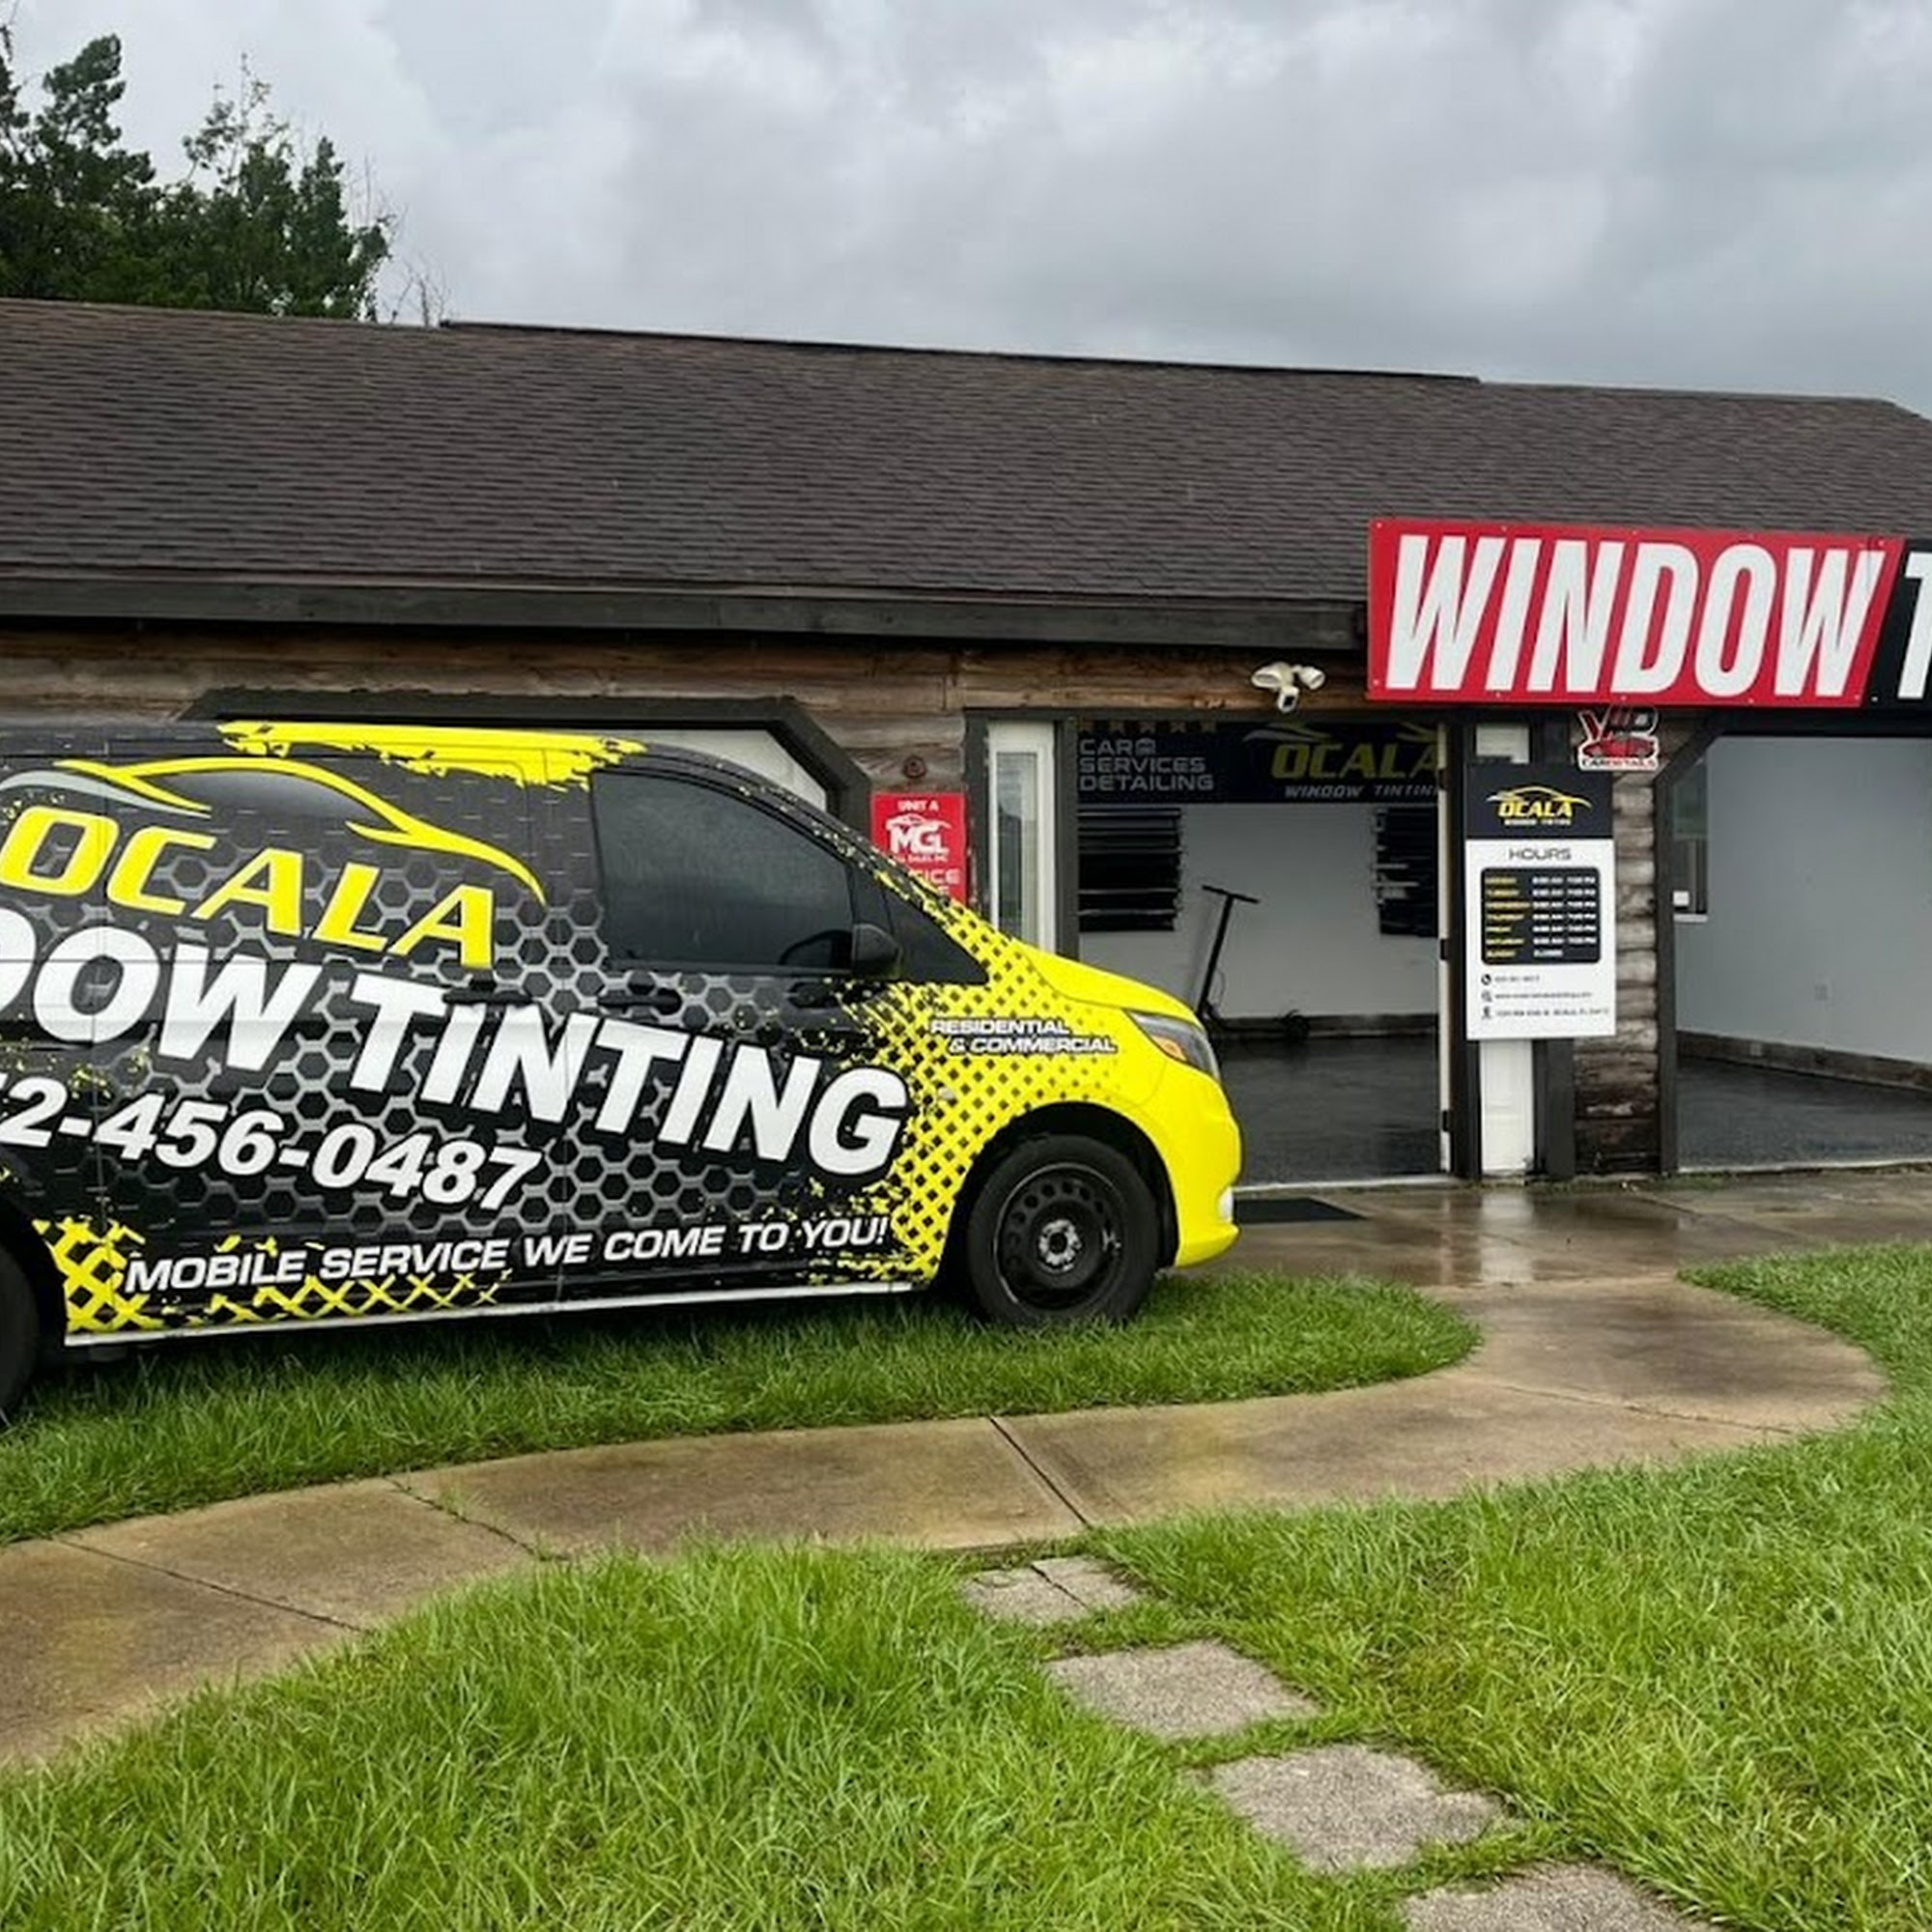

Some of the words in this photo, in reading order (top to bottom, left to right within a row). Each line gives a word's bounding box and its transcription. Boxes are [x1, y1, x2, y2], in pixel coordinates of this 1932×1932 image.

[1385, 534, 1887, 699] WINDOW
[1079, 738, 1134, 756] CAR
[1079, 756, 1207, 774] SERVICES
[1271, 743, 1438, 779] OCALA
[1079, 774, 1214, 791] DETAILING
[1285, 785, 1365, 798] WINDOW
[928, 800, 940, 811] A
[1497, 800, 1573, 818] OCALA
[1509, 848, 1573, 861] HOURS
[0, 806, 495, 969] OCALA
[930, 1018, 1071, 1036] RESIDENTIAL
[949, 1037, 966, 1053] &
[970, 1037, 1119, 1053] COMMERCIAL
[349, 974, 908, 1177] TINTING
[0, 1072, 542, 1211] 2-456-0487
[125, 1249, 307, 1293] MOBILE
[320, 1239, 510, 1280] SERVICE
[524, 1233, 593, 1266] WE
[604, 1225, 726, 1261] COME
[738, 1222, 789, 1253] TO
[801, 1216, 891, 1248] YOU!
